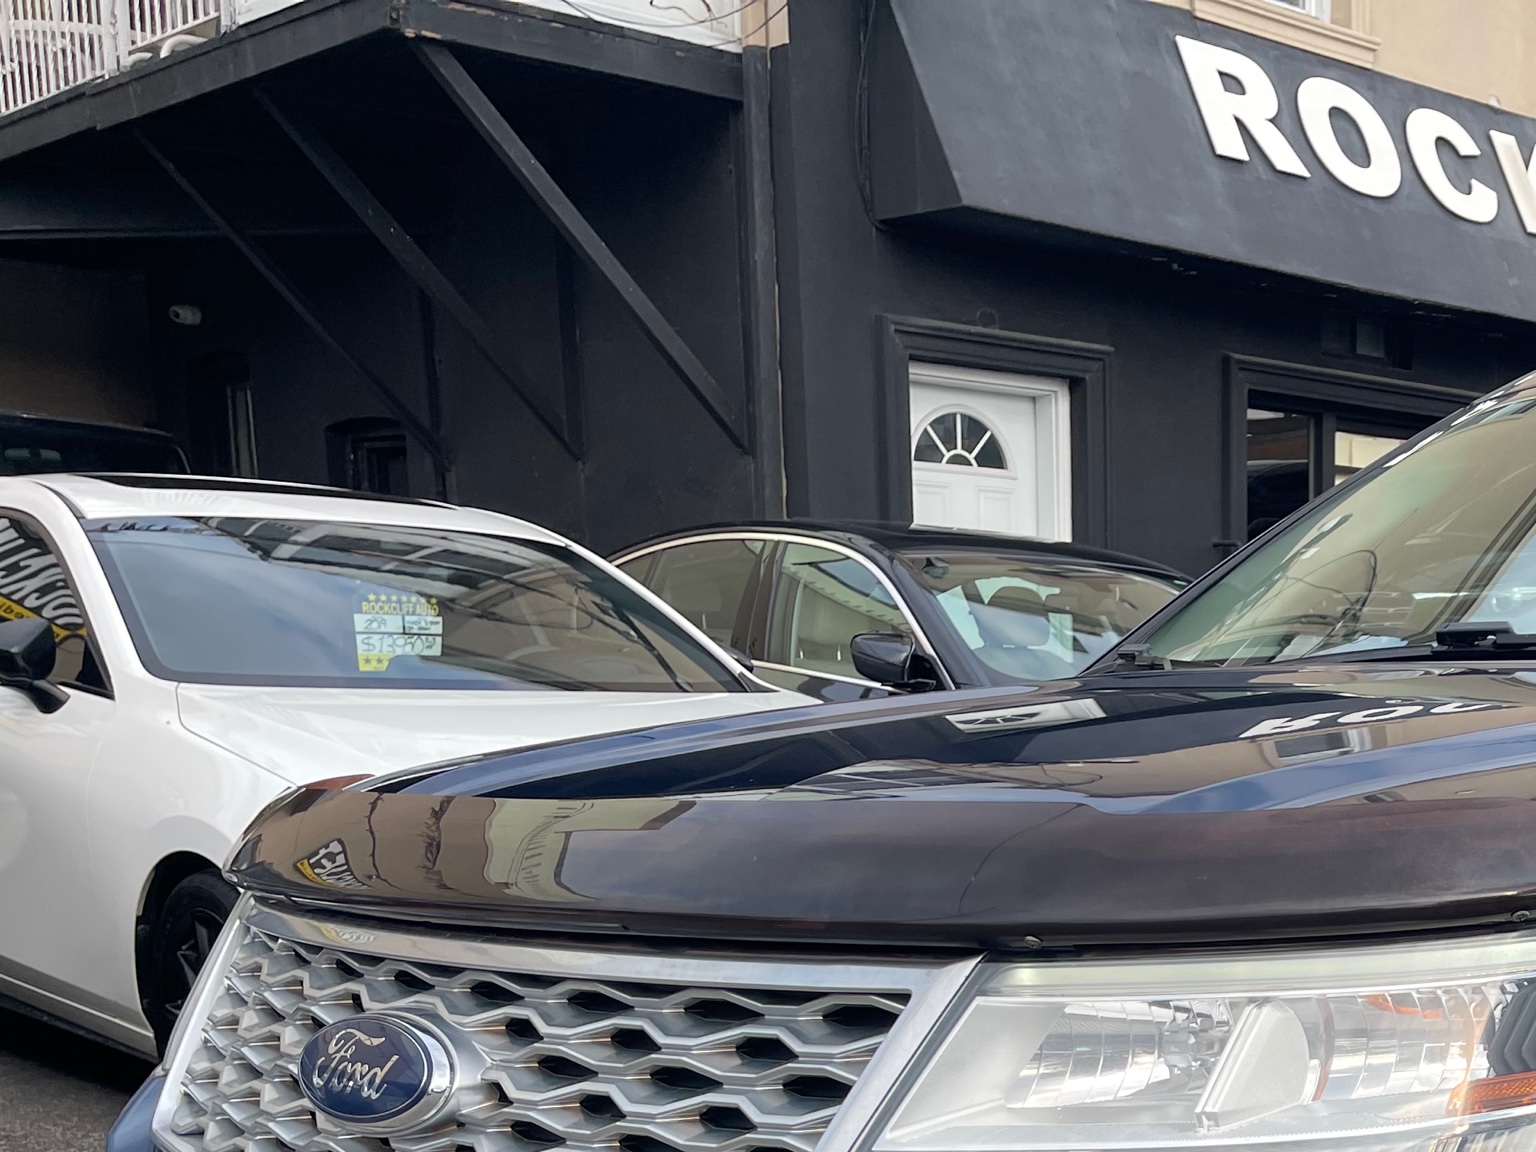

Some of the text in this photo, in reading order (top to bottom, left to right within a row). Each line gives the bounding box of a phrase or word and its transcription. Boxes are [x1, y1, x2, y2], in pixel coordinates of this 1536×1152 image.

[361, 601, 439, 616] ROCKCLIFF AUTO
[312, 1028, 399, 1100] Ford
